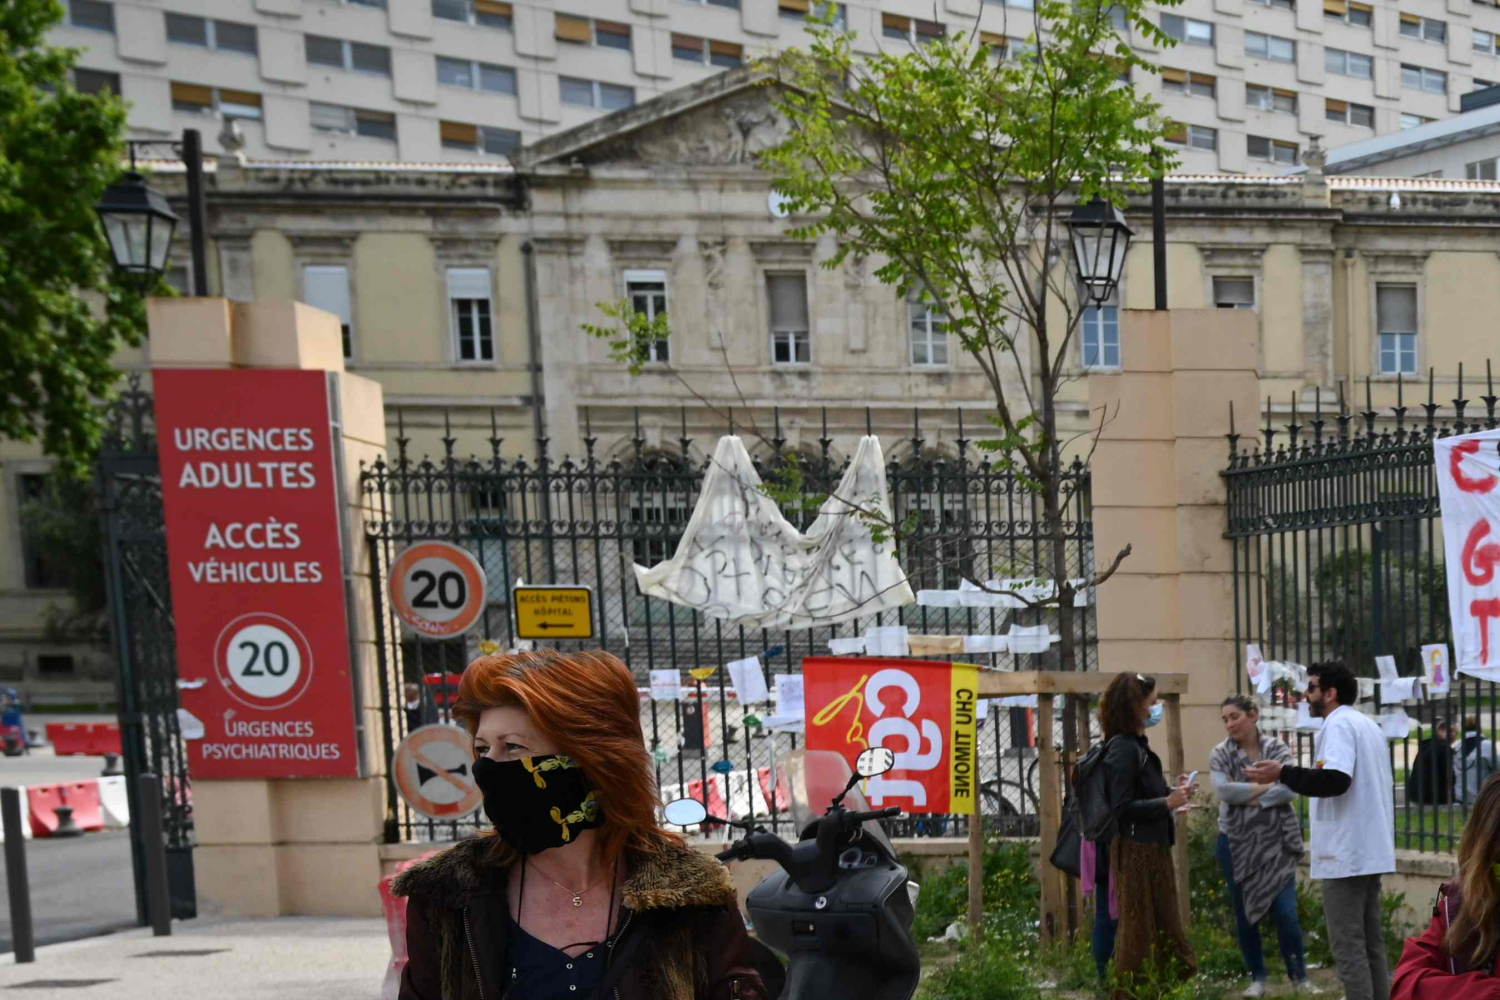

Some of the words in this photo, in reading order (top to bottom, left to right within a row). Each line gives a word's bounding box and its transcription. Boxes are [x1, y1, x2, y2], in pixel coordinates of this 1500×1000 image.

[174, 427, 315, 452] URGENCES
[179, 462, 316, 489] ADULTES
[204, 517, 302, 549] ACCÈS
[188, 558, 323, 584] VÉHICULES
[410, 570, 466, 609] 20
[238, 641, 290, 677] 20
[224, 720, 314, 738] URGENCES
[202, 743, 340, 761] PSYCHIATRIQUES
